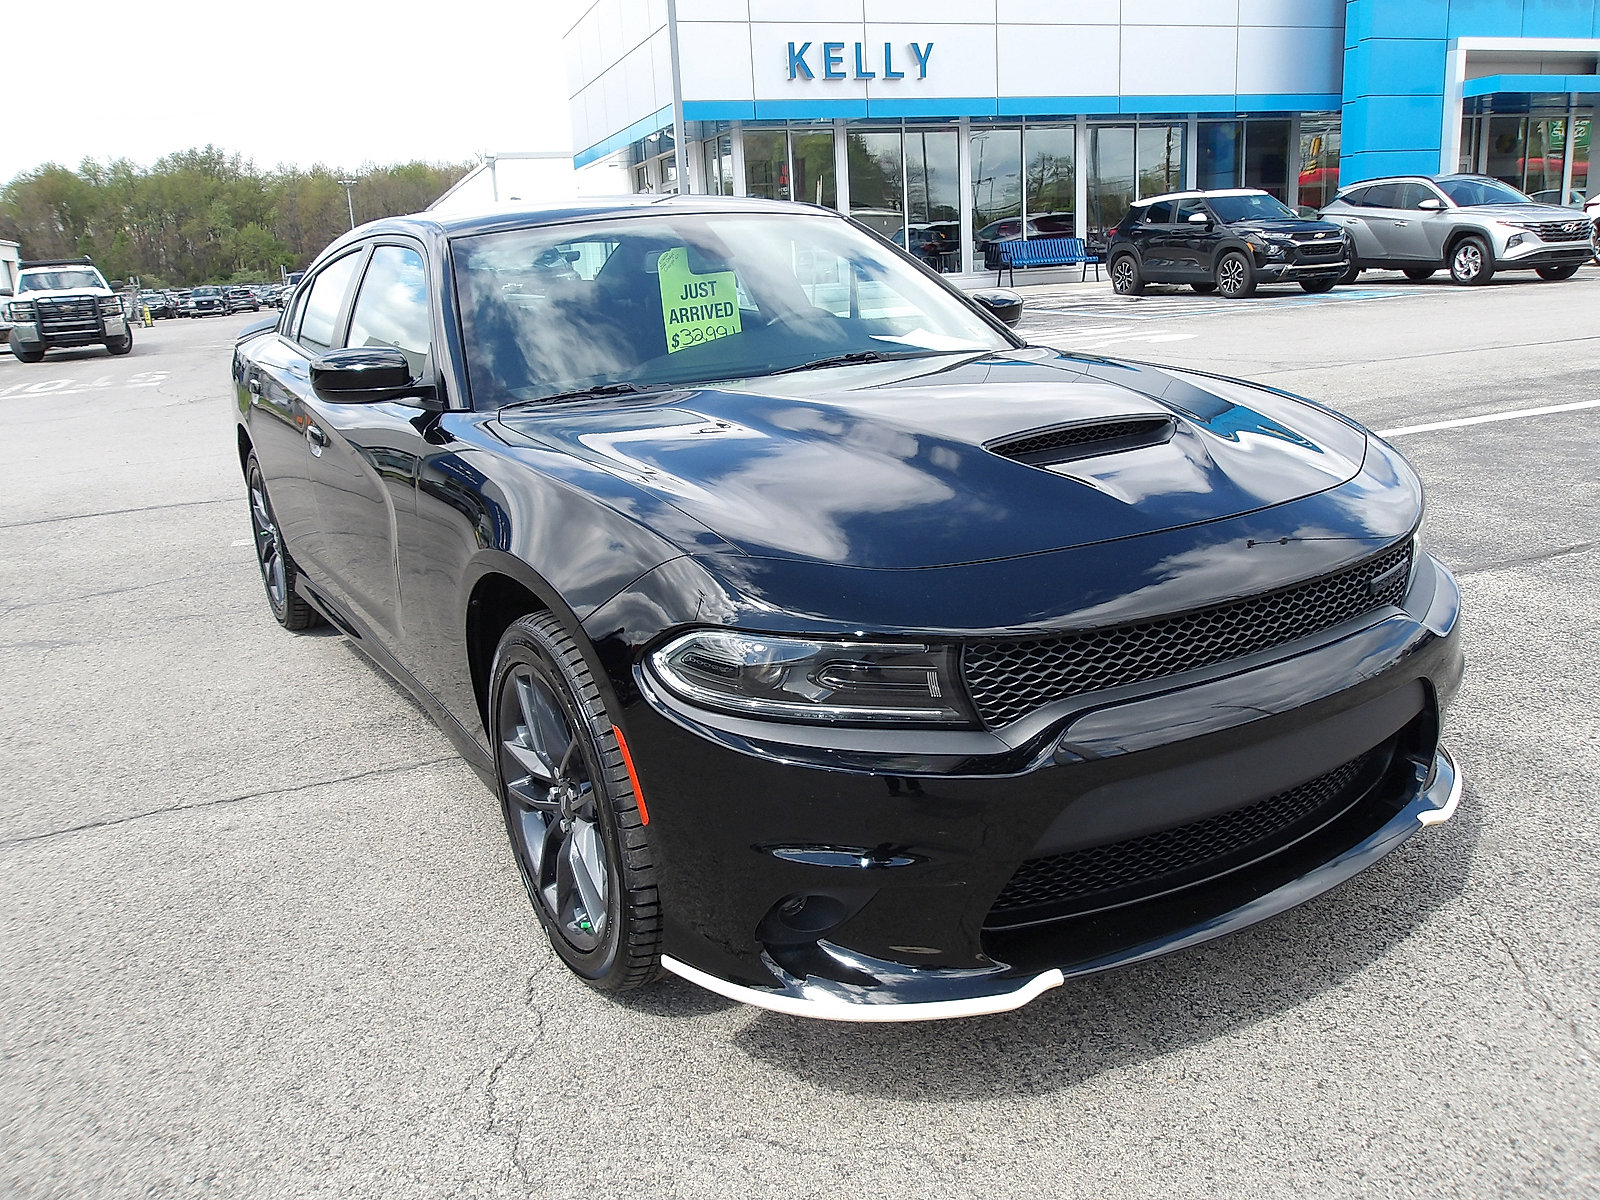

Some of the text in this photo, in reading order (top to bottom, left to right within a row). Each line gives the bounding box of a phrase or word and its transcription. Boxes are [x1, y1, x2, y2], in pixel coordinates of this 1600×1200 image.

[786, 41, 934, 80] KELLY
[680, 281, 717, 300] JUST
[669, 301, 734, 325] ARRIVED
